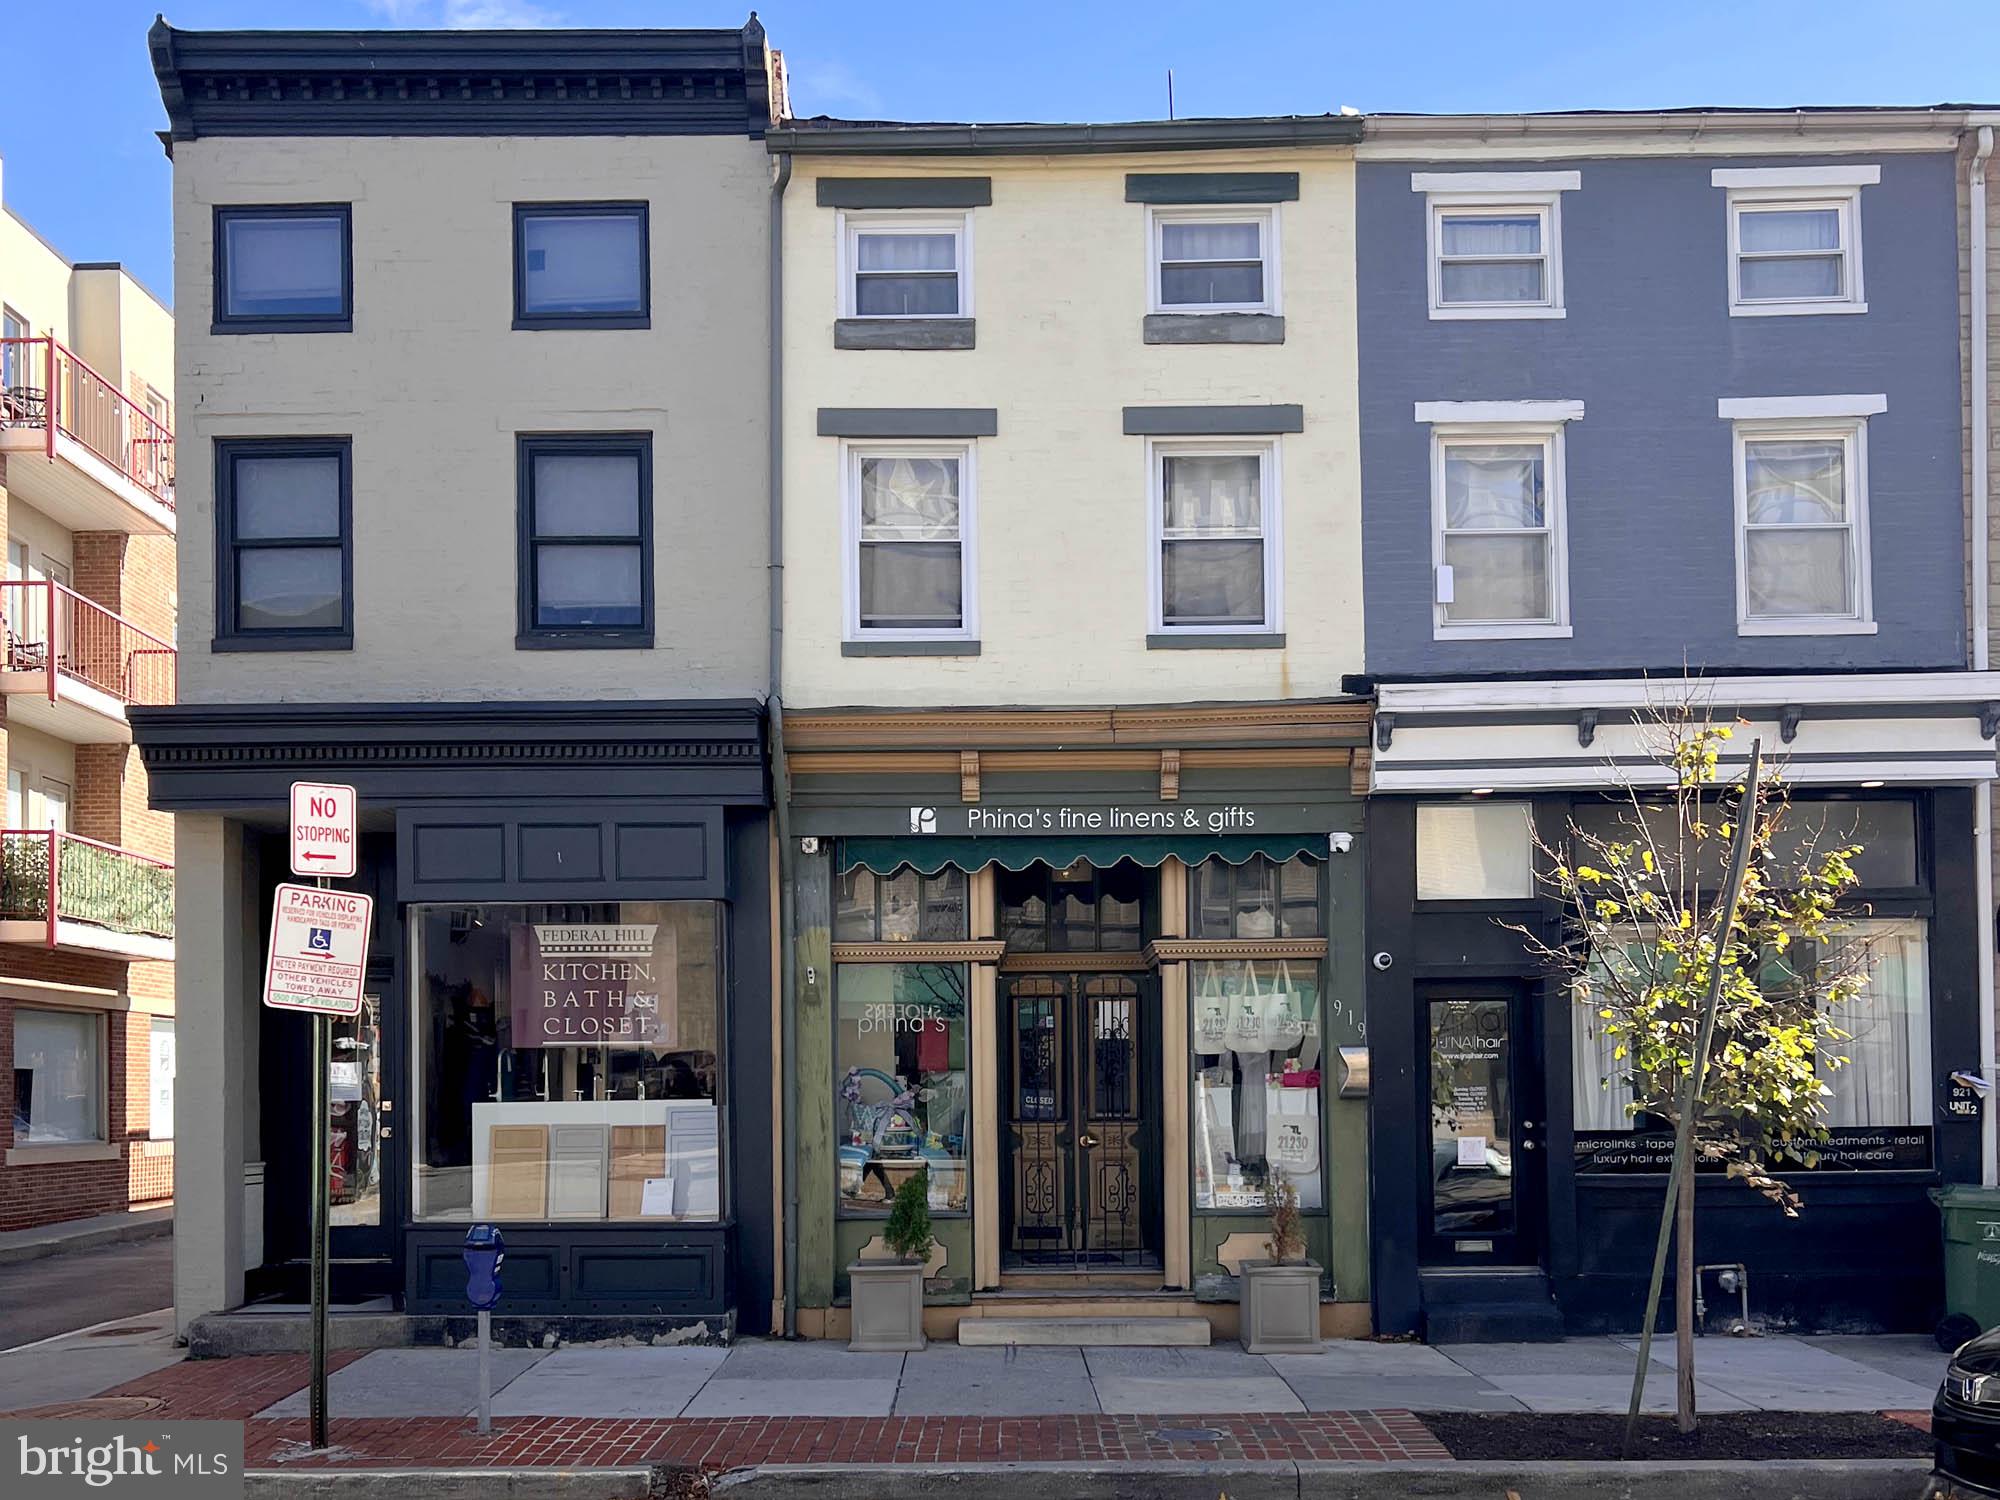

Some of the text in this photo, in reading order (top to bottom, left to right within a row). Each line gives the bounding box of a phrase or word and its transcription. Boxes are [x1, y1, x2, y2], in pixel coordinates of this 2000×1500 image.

[310, 797, 337, 818] NO
[968, 806, 1255, 833] Phina's fine linens & gifts
[297, 825, 350, 844] STOPPING
[291, 892, 357, 913] PARKING
[543, 930, 649, 942] FEDERAL HILL
[275, 959, 358, 977] METER PAYMENT REQUIRED
[543, 963, 657, 984] KITCHEN,
[277, 972, 353, 988] OTHER VEHICLES
[285, 982, 344, 996] TOWED AWAY
[543, 990, 656, 1008] BATH &
[543, 1017, 652, 1035] CLOSET
[1333, 999, 1366, 1039] 919
[1952, 1087, 1971, 1097] 921
[1949, 1101, 1972, 1111] UNIT
[1970, 1105, 1977, 1115] 2
[1277, 1135, 1309, 1149] 21230
[1576, 1138, 1636, 1149] microlinks
[1772, 1136, 1816, 1147] custom
[1894, 1135, 1924, 1145] retail
[1593, 1153, 1628, 1164] luxury
[1631, 1154, 1652, 1164] hair
[1840, 1150, 1862, 1160] hair
[1865, 1152, 1894, 1161] care
